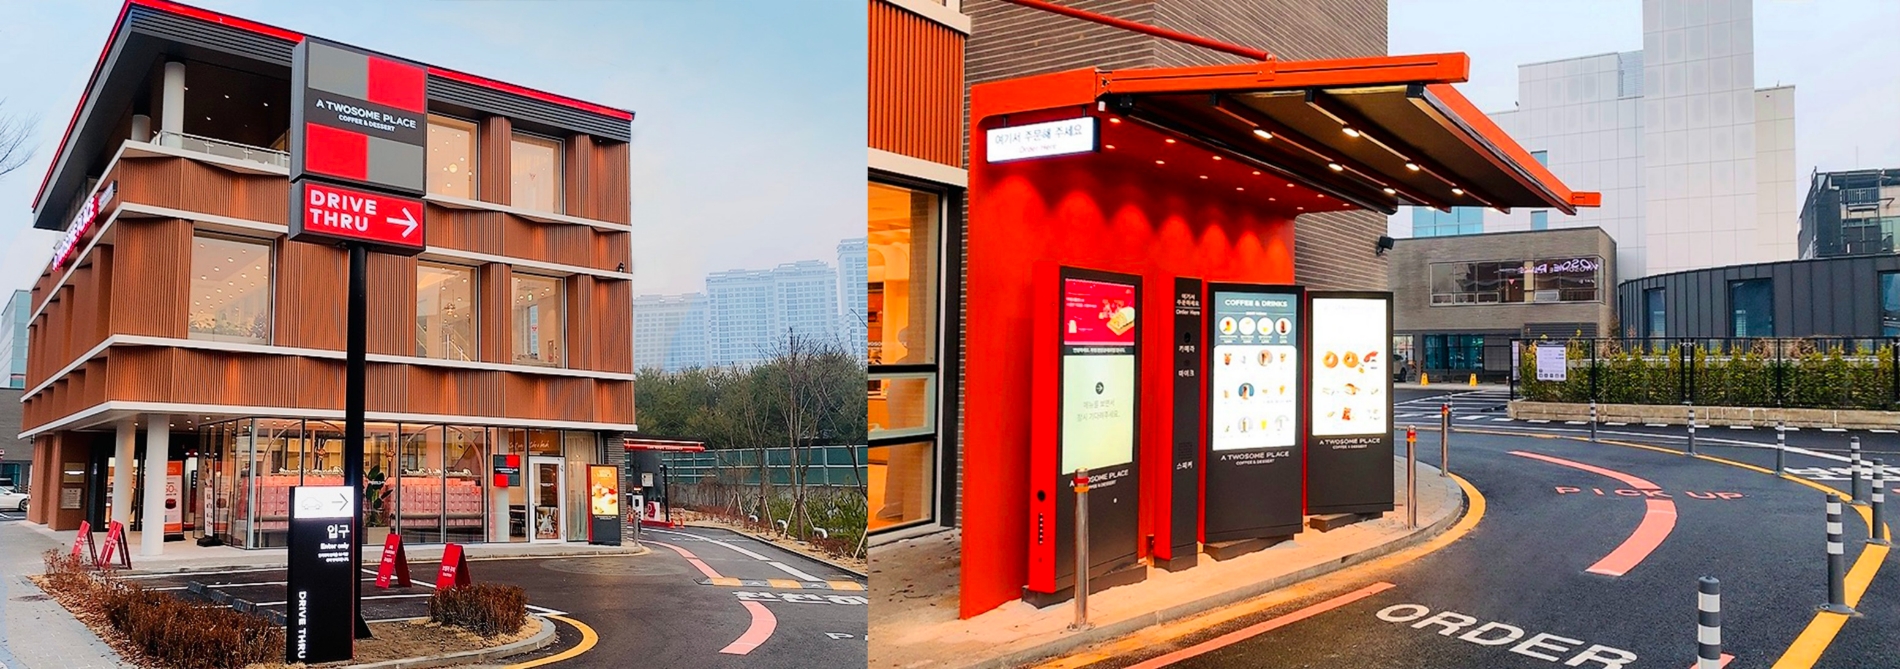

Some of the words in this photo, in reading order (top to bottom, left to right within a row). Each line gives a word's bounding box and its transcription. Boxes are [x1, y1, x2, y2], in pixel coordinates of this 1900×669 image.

[316, 99, 325, 109] A
[325, 101, 380, 121] TWOSOME
[382, 114, 416, 129] PLACE
[339, 114, 363, 126] COFFEE
[368, 120, 395, 132] DESSERT
[995, 133, 1021, 145] 여기서
[1025, 128, 1051, 142] 주문해
[1055, 124, 1082, 137] 주세요
[310, 190, 377, 216] DRIVE
[309, 208, 369, 232] THRU
[1224, 299, 1253, 307] COFFEE
[1261, 300, 1288, 308] DRINKS
[1178, 345, 1195, 353] 카메라
[1178, 369, 1195, 377] 마이크
[1227, 452, 1265, 460] TWOSOME
[1109, 469, 1129, 478] PLACE
[1176, 460, 1193, 470] 스피커
[1555, 485, 1674, 499] PICK
[1686, 491, 1745, 500] UP
[327, 523, 350, 539] 입구
[298, 591, 307, 626] DRIVE
[297, 628, 307, 659] THRU
[1376, 604, 1638, 669] ORDER
